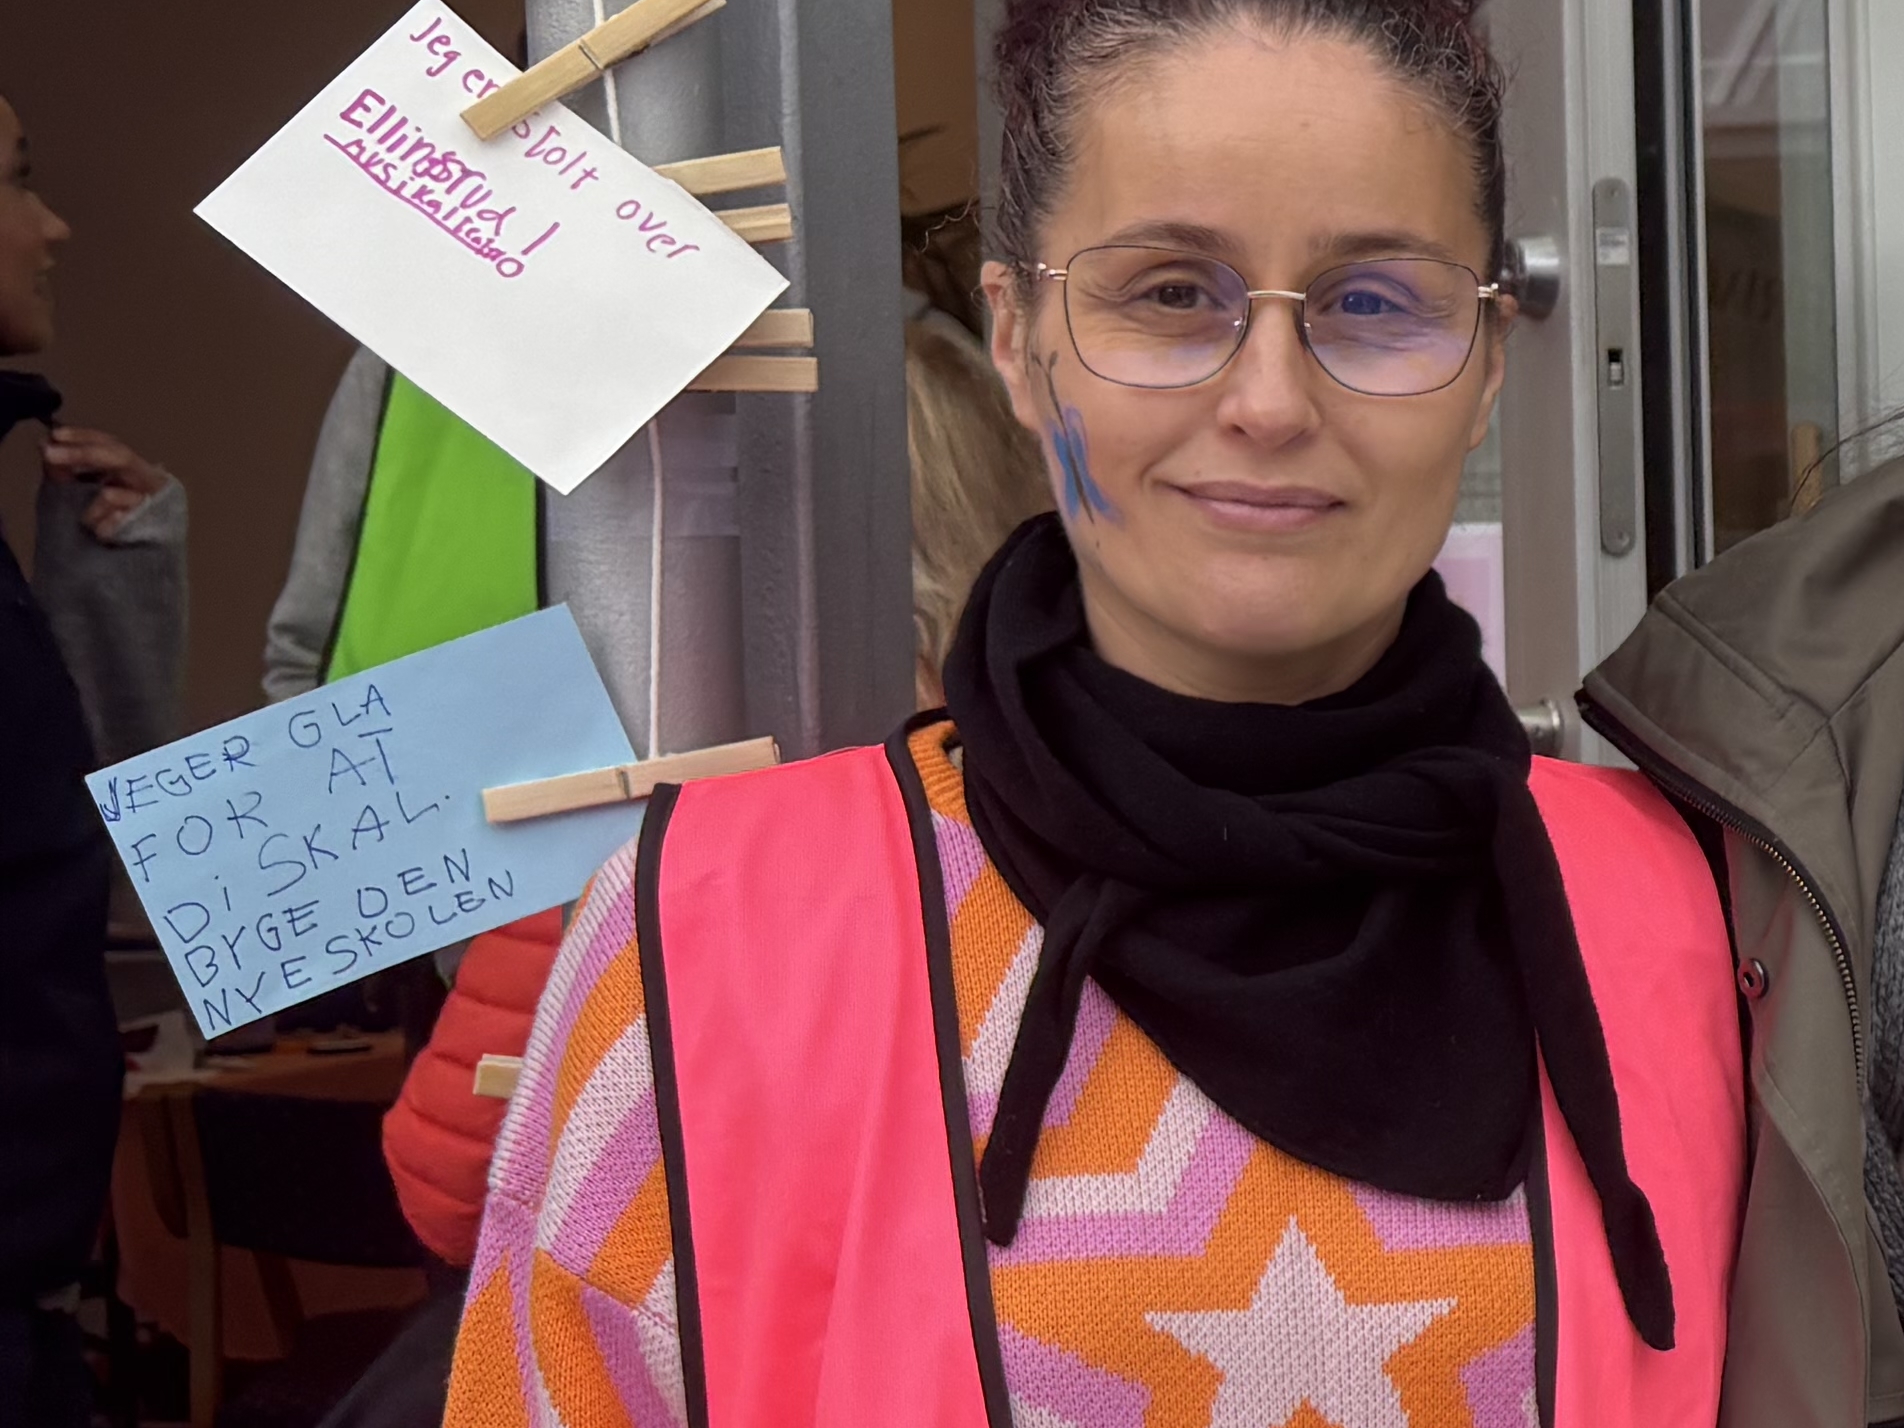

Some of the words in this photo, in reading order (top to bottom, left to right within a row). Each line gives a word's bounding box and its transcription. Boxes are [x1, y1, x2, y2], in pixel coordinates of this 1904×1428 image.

[616, 198, 700, 258] over
[289, 684, 391, 747] GLA
[131, 791, 268, 882] FOR
[328, 728, 393, 794] AT
[357, 848, 471, 918] DEN
